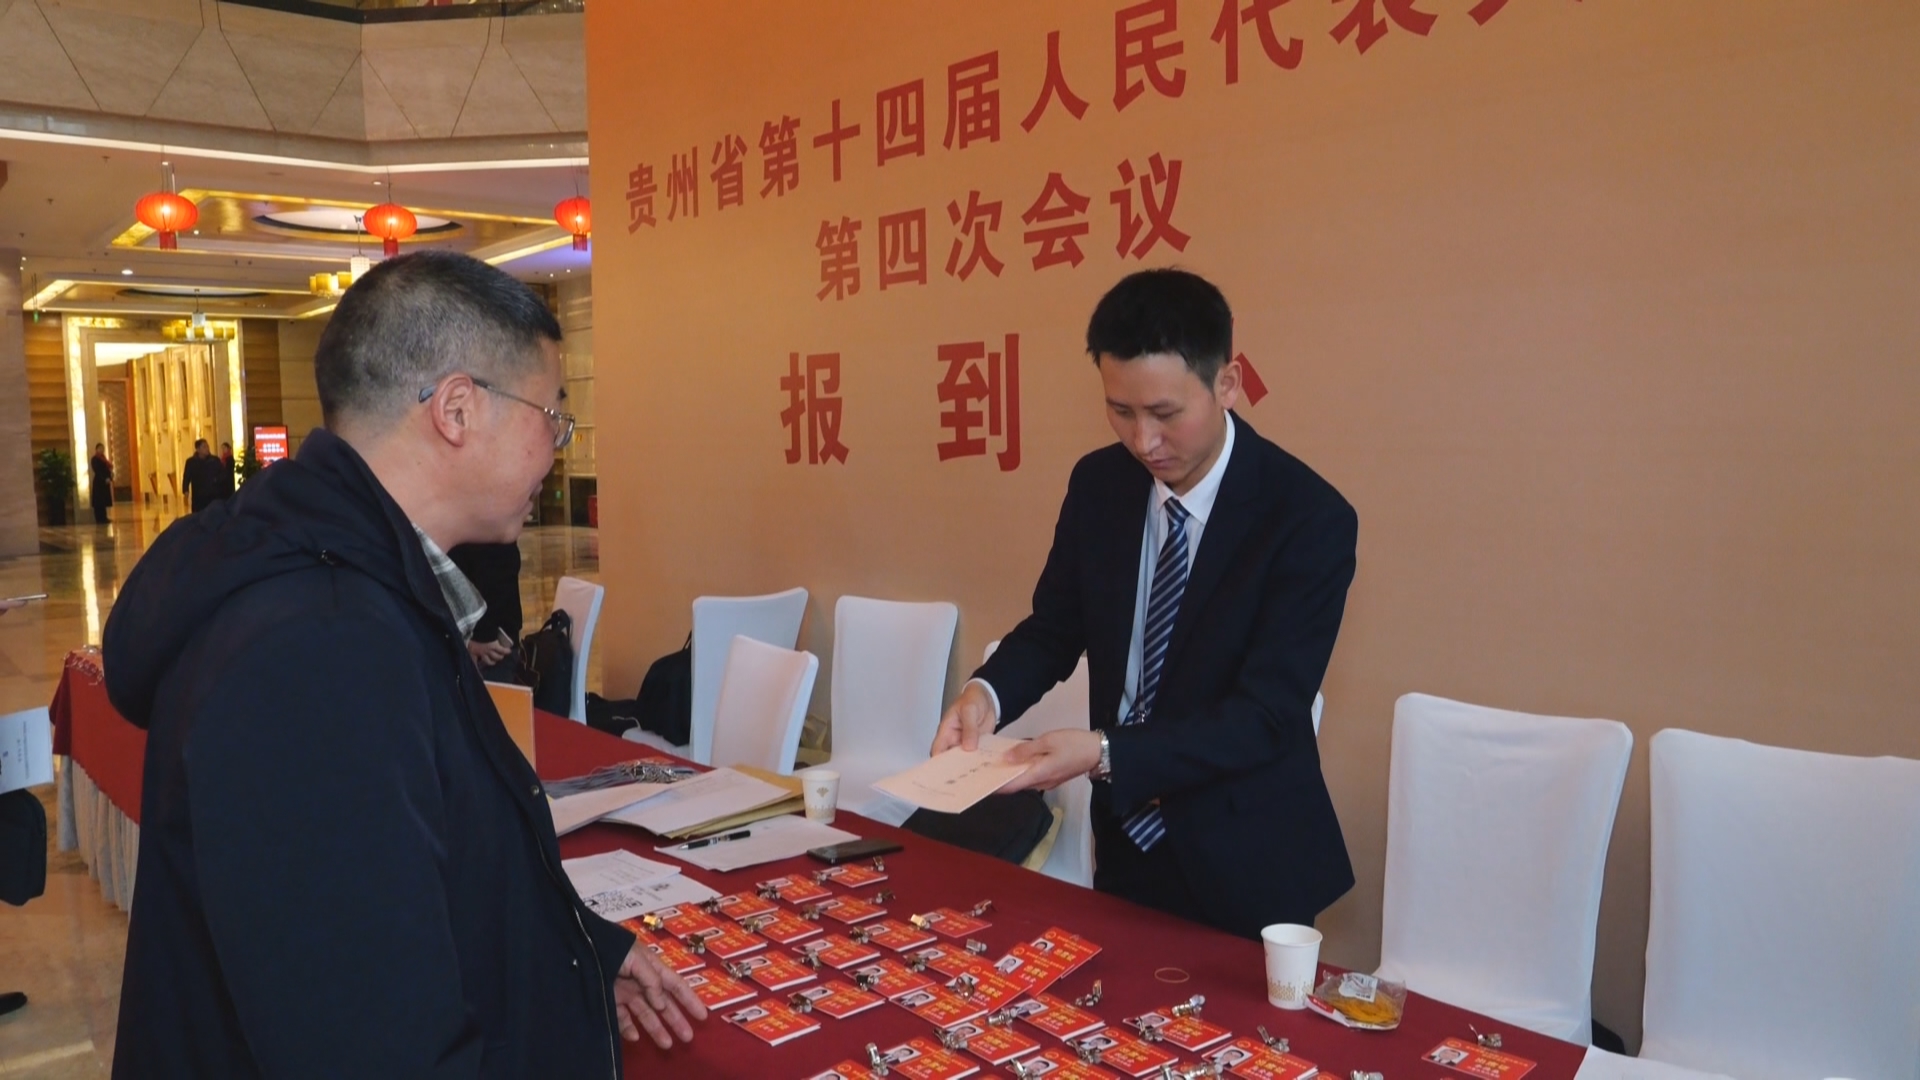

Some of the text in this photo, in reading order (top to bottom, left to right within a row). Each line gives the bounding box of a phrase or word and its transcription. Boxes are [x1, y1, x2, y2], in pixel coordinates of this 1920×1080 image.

[626, 0, 1505, 235] 贵州省第十四届人民代
[815, 152, 1191, 302] 第四次会议
